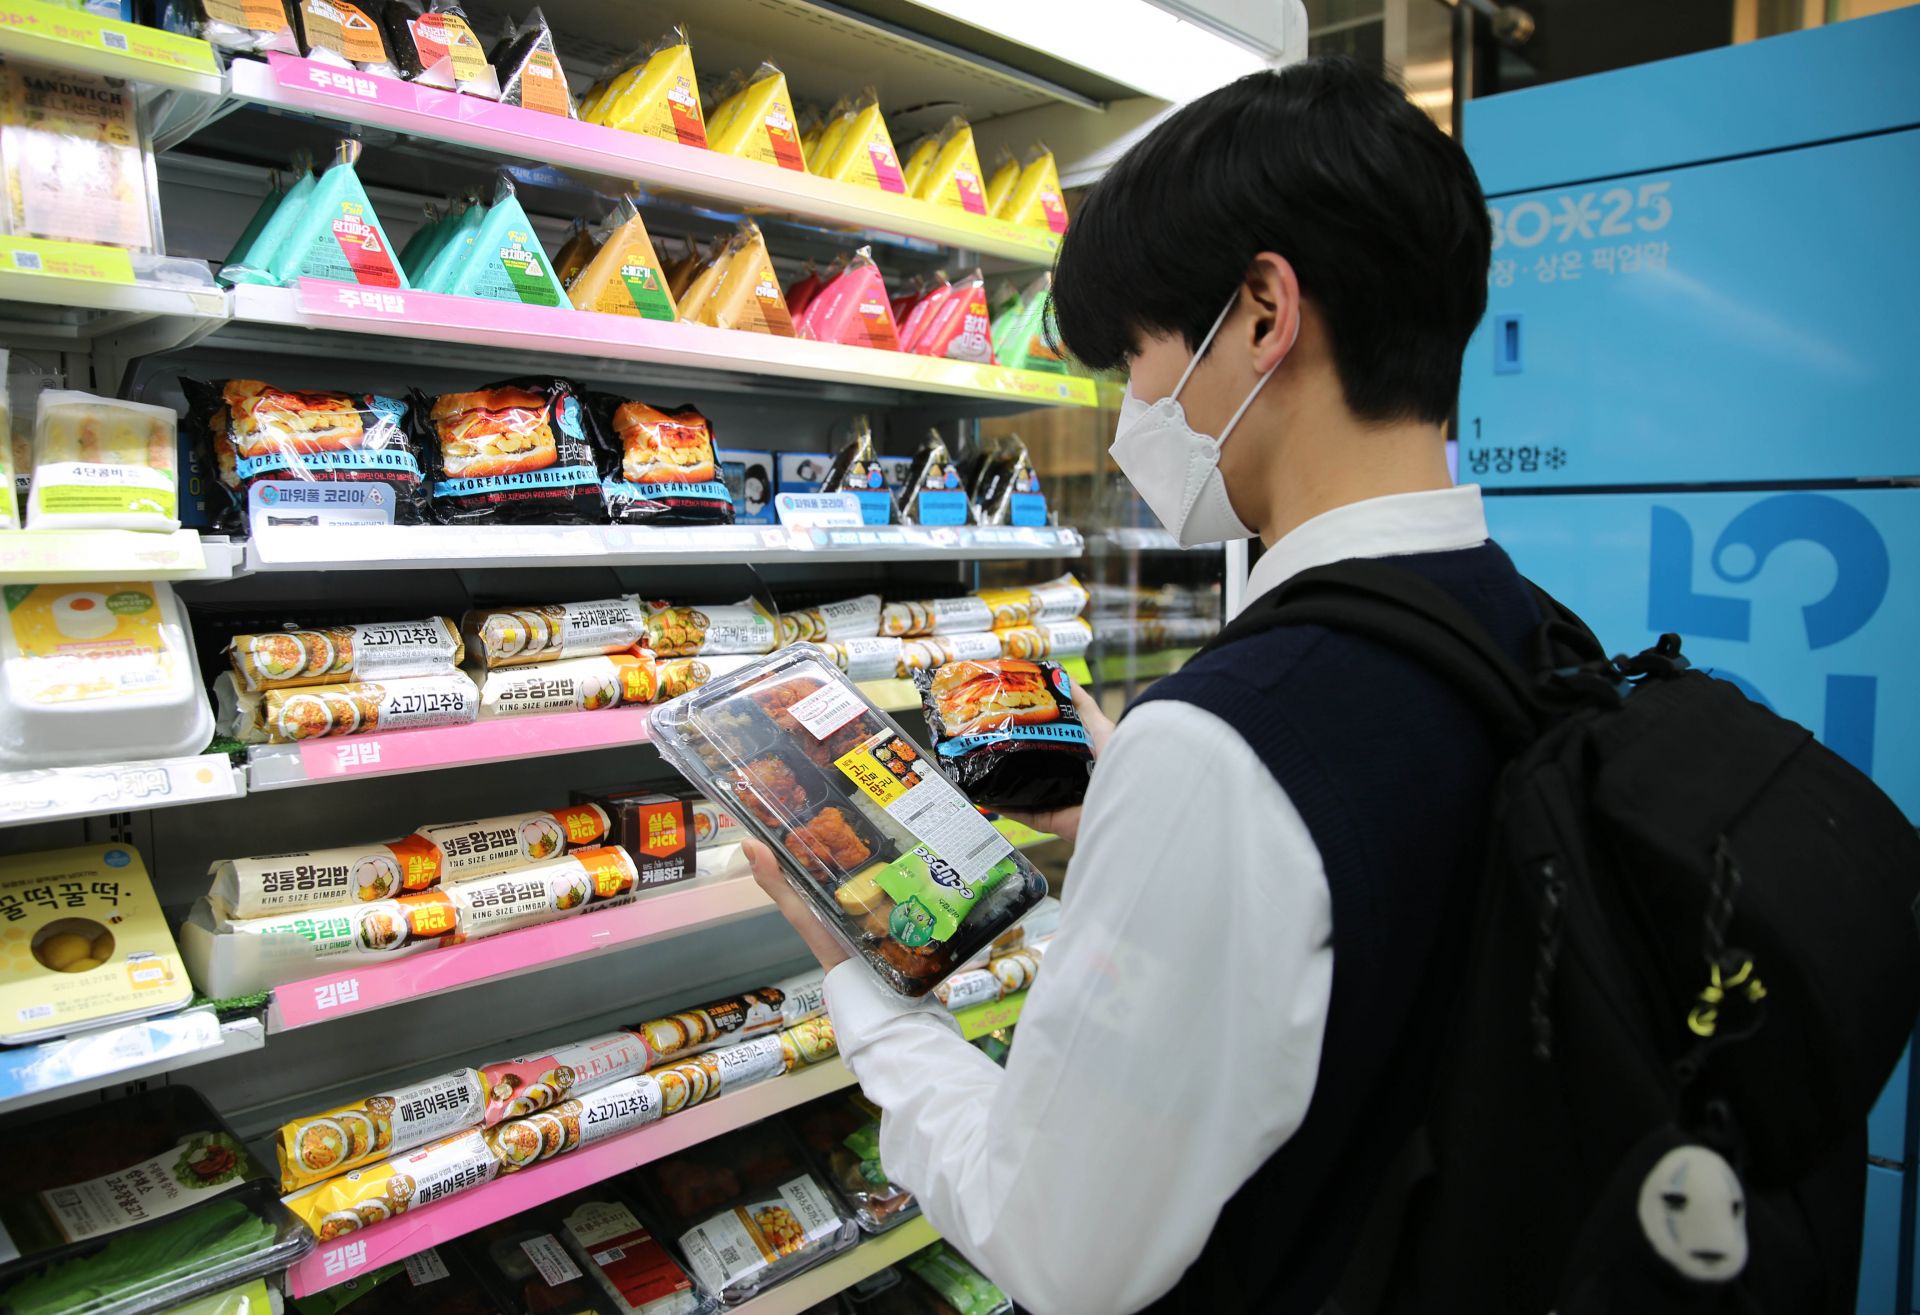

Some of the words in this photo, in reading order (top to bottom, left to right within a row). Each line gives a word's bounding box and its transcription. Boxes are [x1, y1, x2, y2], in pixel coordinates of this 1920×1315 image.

[23, 75, 122, 105] SANDWICH
[308, 67, 378, 99] 주먹밥
[338, 288, 405, 314] 주먹밥
[1472, 417, 1482, 440] 1
[1468, 446, 1540, 474] 냉장함
[72, 466, 123, 478] 4단콤비
[459, 474, 511, 491] KOREAN
[518, 471, 560, 484] ZOMBIE
[279, 488, 320, 503] 파워풀
[324, 489, 365, 504] 코리아
[640, 482, 684, 496] KOREAN
[569, 608, 634, 630] 뉴참치햄샐러드
[362, 627, 438, 646] 소고기고추장
[711, 627, 748, 642] 전주비빔
[389, 693, 464, 714] 소고기고추장
[499, 703, 519, 711] KING
[522, 702, 541, 710] SIZE
[544, 700, 573, 709] GIMBAP
[1022, 727, 1065, 737] ZOMBIE
[336, 741, 381, 768] 김밥
[566, 812, 594, 829] 실속
[648, 812, 677, 832] 실속
[442, 828, 518, 857] 정통왕김밥
[571, 826, 596, 839] PICK
[649, 834, 677, 849] PICK
[468, 855, 487, 866] SIZE
[489, 848, 519, 861] GIMBAP
[261, 865, 349, 893] 정통왕김밥
[641, 866, 685, 884] 커플SET
[912, 846, 975, 900] eclipse
[261, 896, 284, 905] KING
[288, 893, 309, 903] SIZE
[313, 889, 347, 901] GIMBAP
[467, 879, 546, 907] 정통왕김밥
[472, 910, 492, 920] KING
[495, 907, 514, 917] SIZE
[517, 901, 547, 913] GIMBAP
[416, 915, 447, 932] PICK
[329, 939, 352, 951] GIMBAP
[313, 978, 360, 1011] 김밥
[575, 1046, 631, 1083] B.E.L.T
[720, 1043, 765, 1068] 치즈돈까스
[400, 1085, 470, 1122] 매콤어묵듬뿍
[587, 1095, 649, 1125] 소고기고추장
[419, 1161, 488, 1205] 매콤어묵듬뿍
[322, 1239, 367, 1278] 김밥
